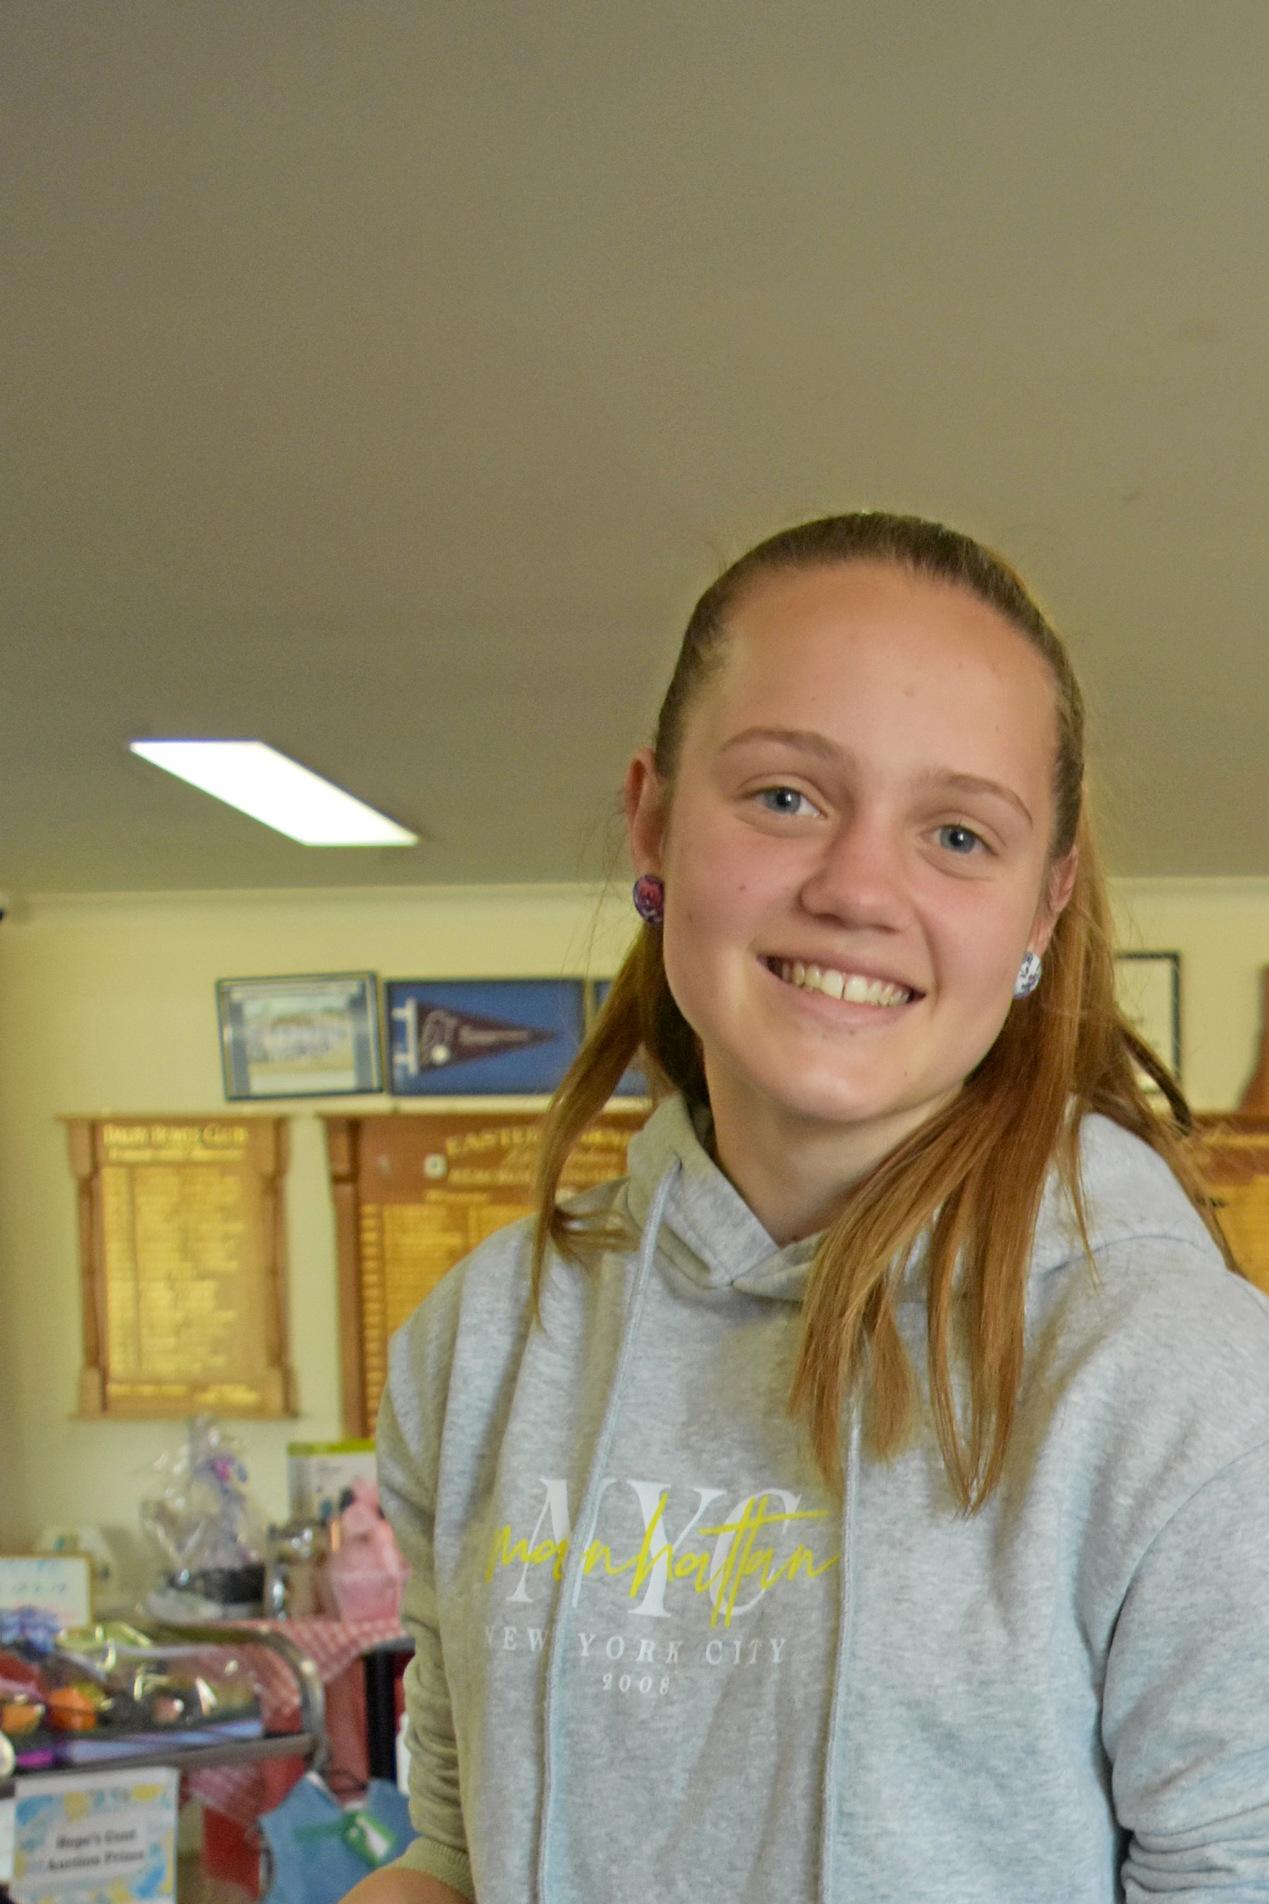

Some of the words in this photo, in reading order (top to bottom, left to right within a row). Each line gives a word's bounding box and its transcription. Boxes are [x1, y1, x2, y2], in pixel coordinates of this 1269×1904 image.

[507, 1476, 802, 1617] NYC
[577, 1632, 684, 1665] YORK
[705, 1638, 787, 1665] CITY
[601, 1672, 670, 1696] 2008
